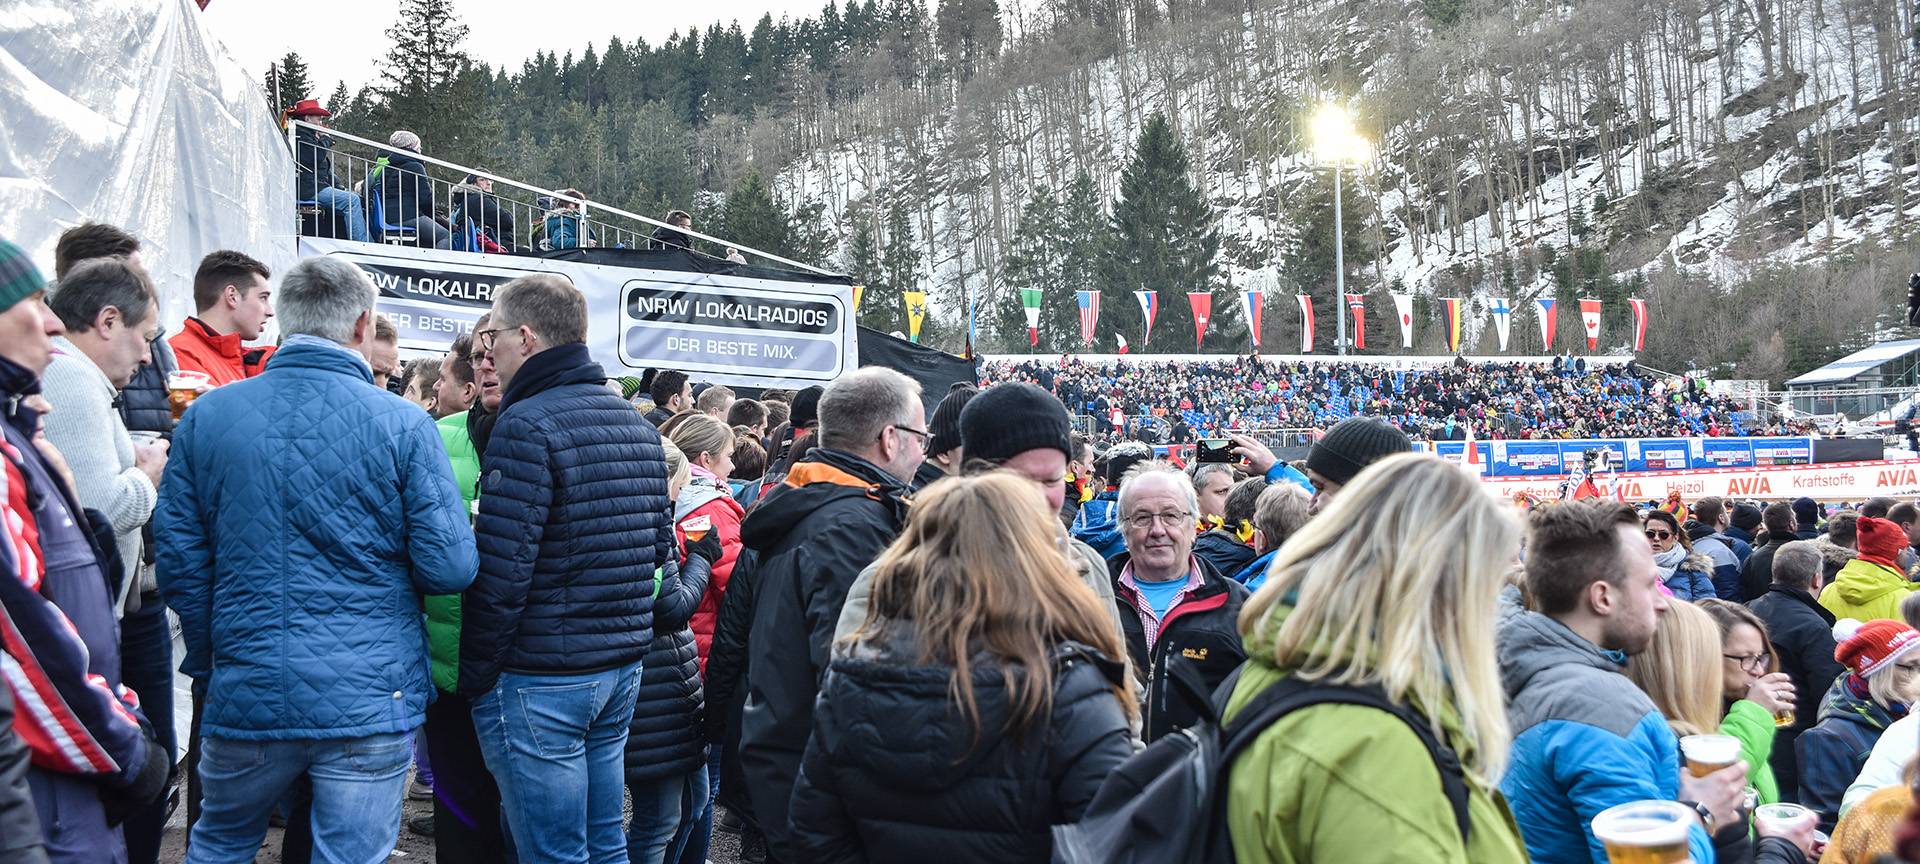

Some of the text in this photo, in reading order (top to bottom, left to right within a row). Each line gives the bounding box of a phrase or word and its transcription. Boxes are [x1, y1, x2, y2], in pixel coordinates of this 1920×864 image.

[638, 297, 828, 327] NRW LOKALRADIOS
[666, 336, 798, 360] DER BESTE MIX.
[1666, 480, 1704, 494] Heizöl
[1727, 473, 1772, 496] AVIA
[1793, 472, 1855, 488] Kraftstoffe
[1876, 465, 1918, 488] AVIA
